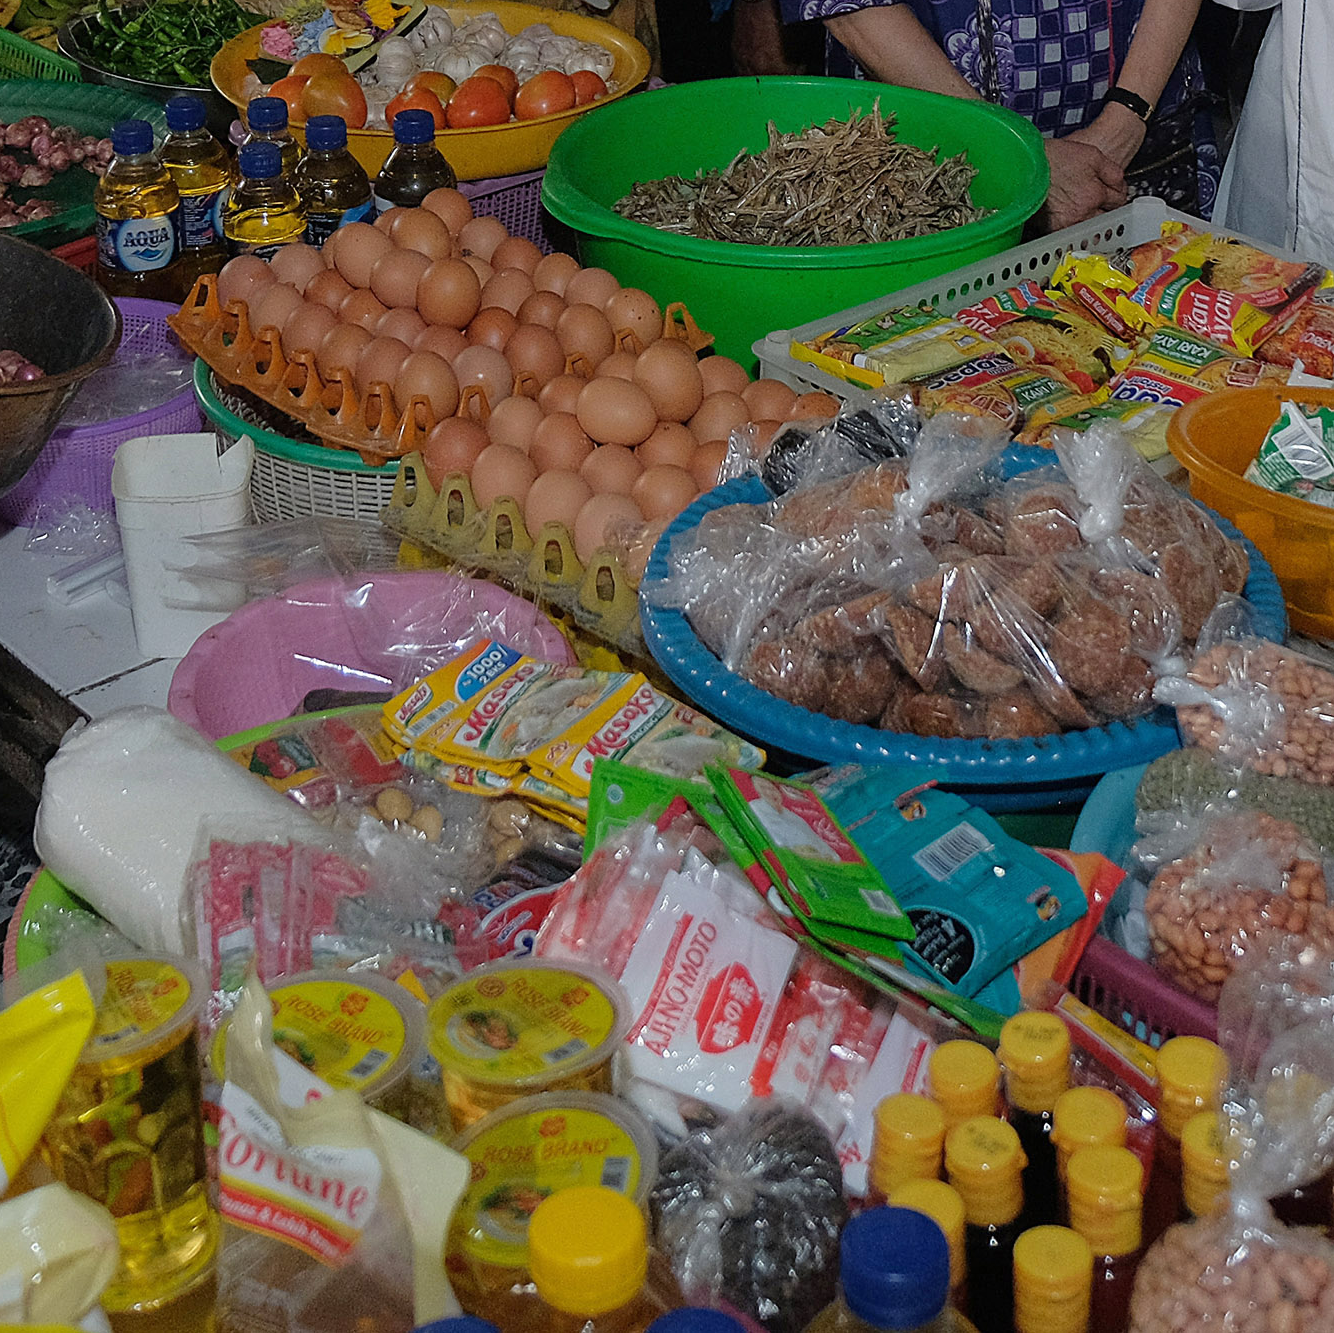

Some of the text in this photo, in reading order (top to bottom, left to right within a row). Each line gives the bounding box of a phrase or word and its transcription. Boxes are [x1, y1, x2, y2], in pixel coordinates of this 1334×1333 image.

[122, 228, 171, 248] AQUA
[1154, 333, 1214, 361] KARI AYA
[1130, 375, 1171, 394] Instant
[466, 644, 509, 683] 1000/
[464, 662, 536, 744] Masako
[583, 686, 656, 776] Masako
[707, 975, 757, 1050] 味の素
[327, 1016, 386, 1045] BRAND
[483, 1138, 610, 1164] ROSE BRAND
